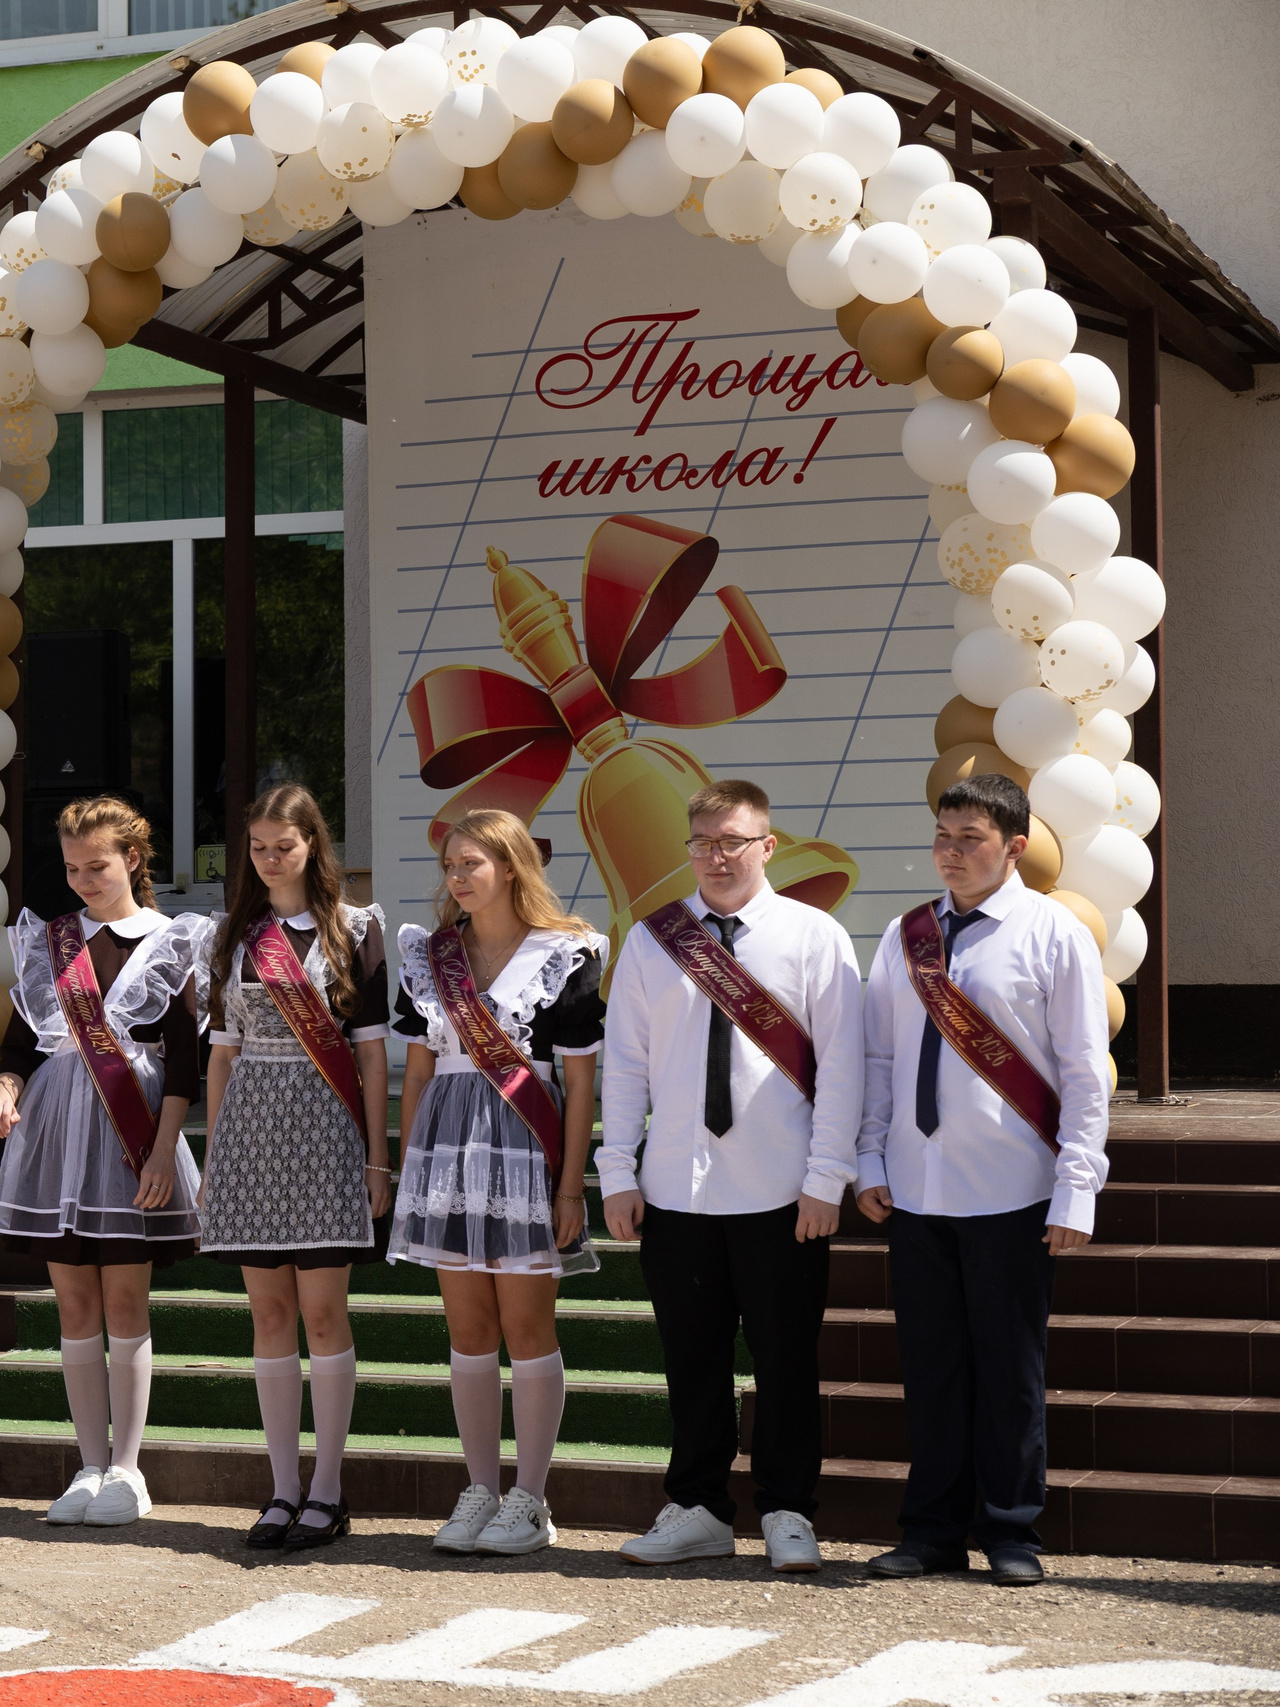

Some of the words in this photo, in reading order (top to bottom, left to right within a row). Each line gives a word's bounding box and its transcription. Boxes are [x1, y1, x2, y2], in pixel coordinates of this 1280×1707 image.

[535, 308, 912, 437] Проща
[537, 417, 839, 498] школа!
[58, 938, 93, 1023] Выпускница
[86, 1024, 116, 1055] 2026
[256, 937, 313, 1021] Выпускница
[306, 1019, 340, 1051] 2026
[440, 958, 489, 1045] Выпускница
[483, 1041, 522, 1074] 2026
[675, 930, 745, 1000] Выпускник
[741, 997, 784, 1031] 2026
[917, 957, 975, 1036] Выпускник
[970, 1032, 1014, 1067] 2026
